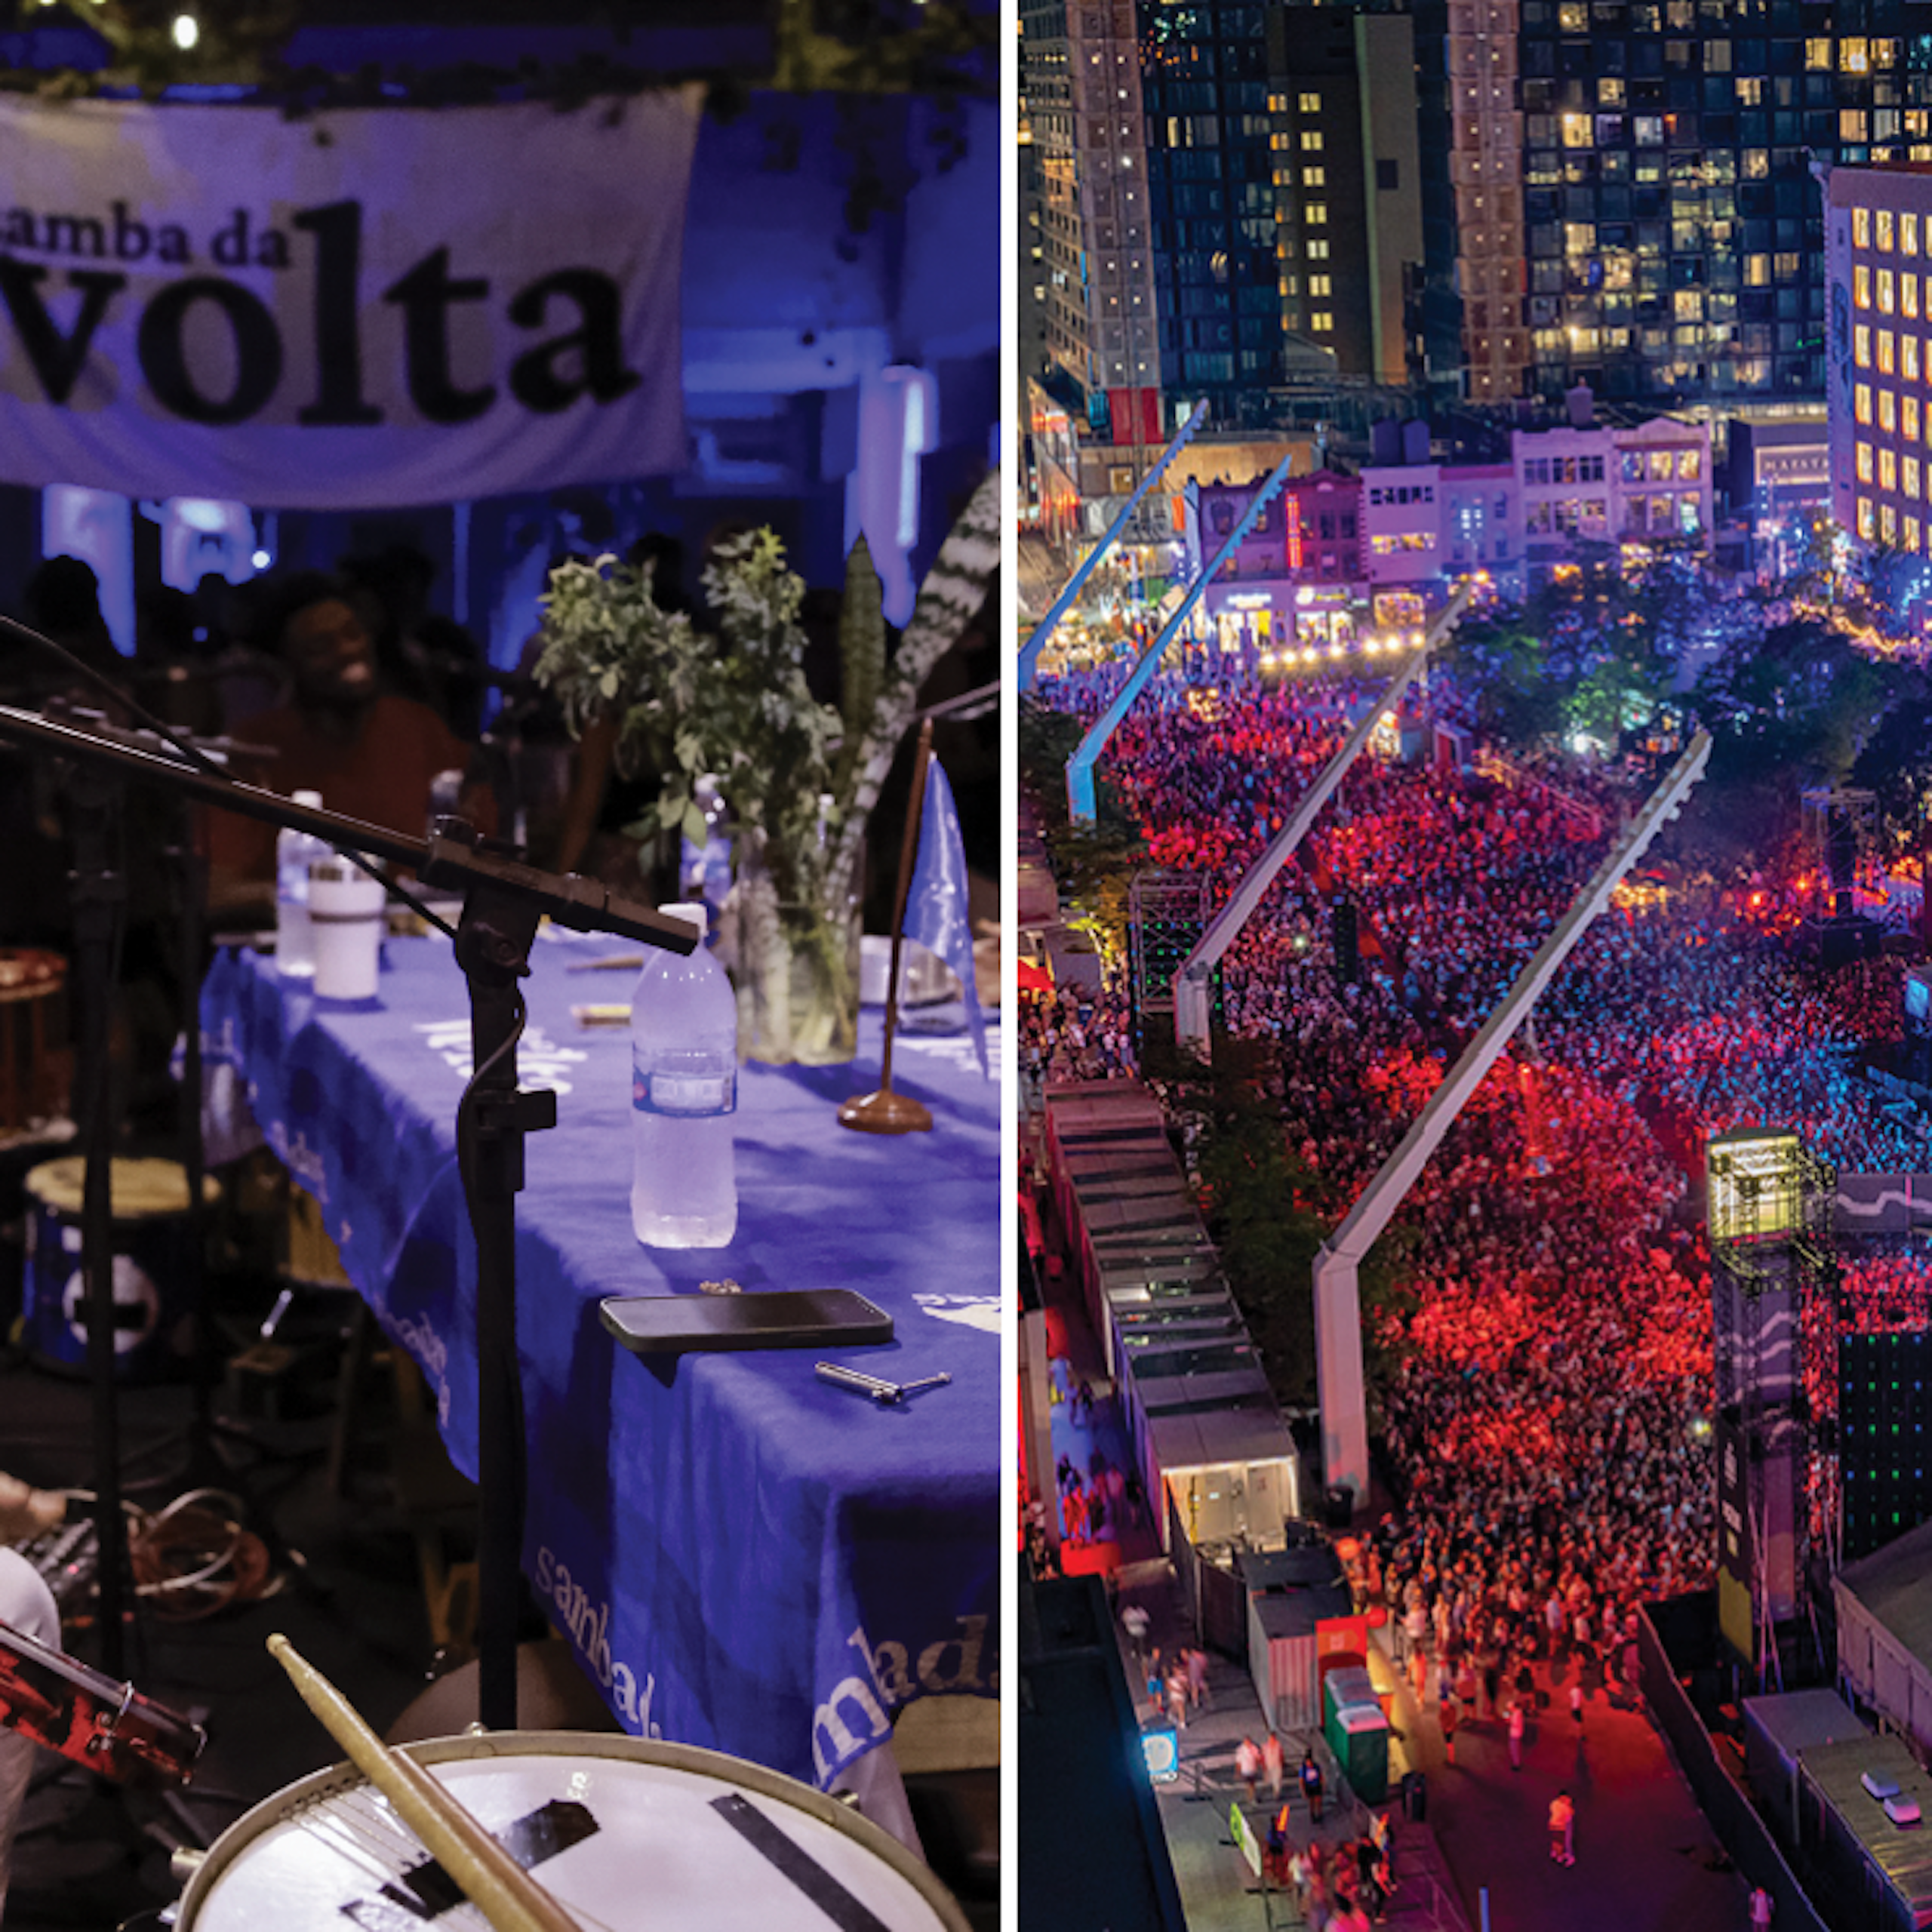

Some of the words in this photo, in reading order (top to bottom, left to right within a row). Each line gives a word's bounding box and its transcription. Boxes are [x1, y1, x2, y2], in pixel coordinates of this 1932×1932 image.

[0, 199, 192, 263] amba
[211, 209, 294, 267] da
[0, 200, 641, 428] volta
